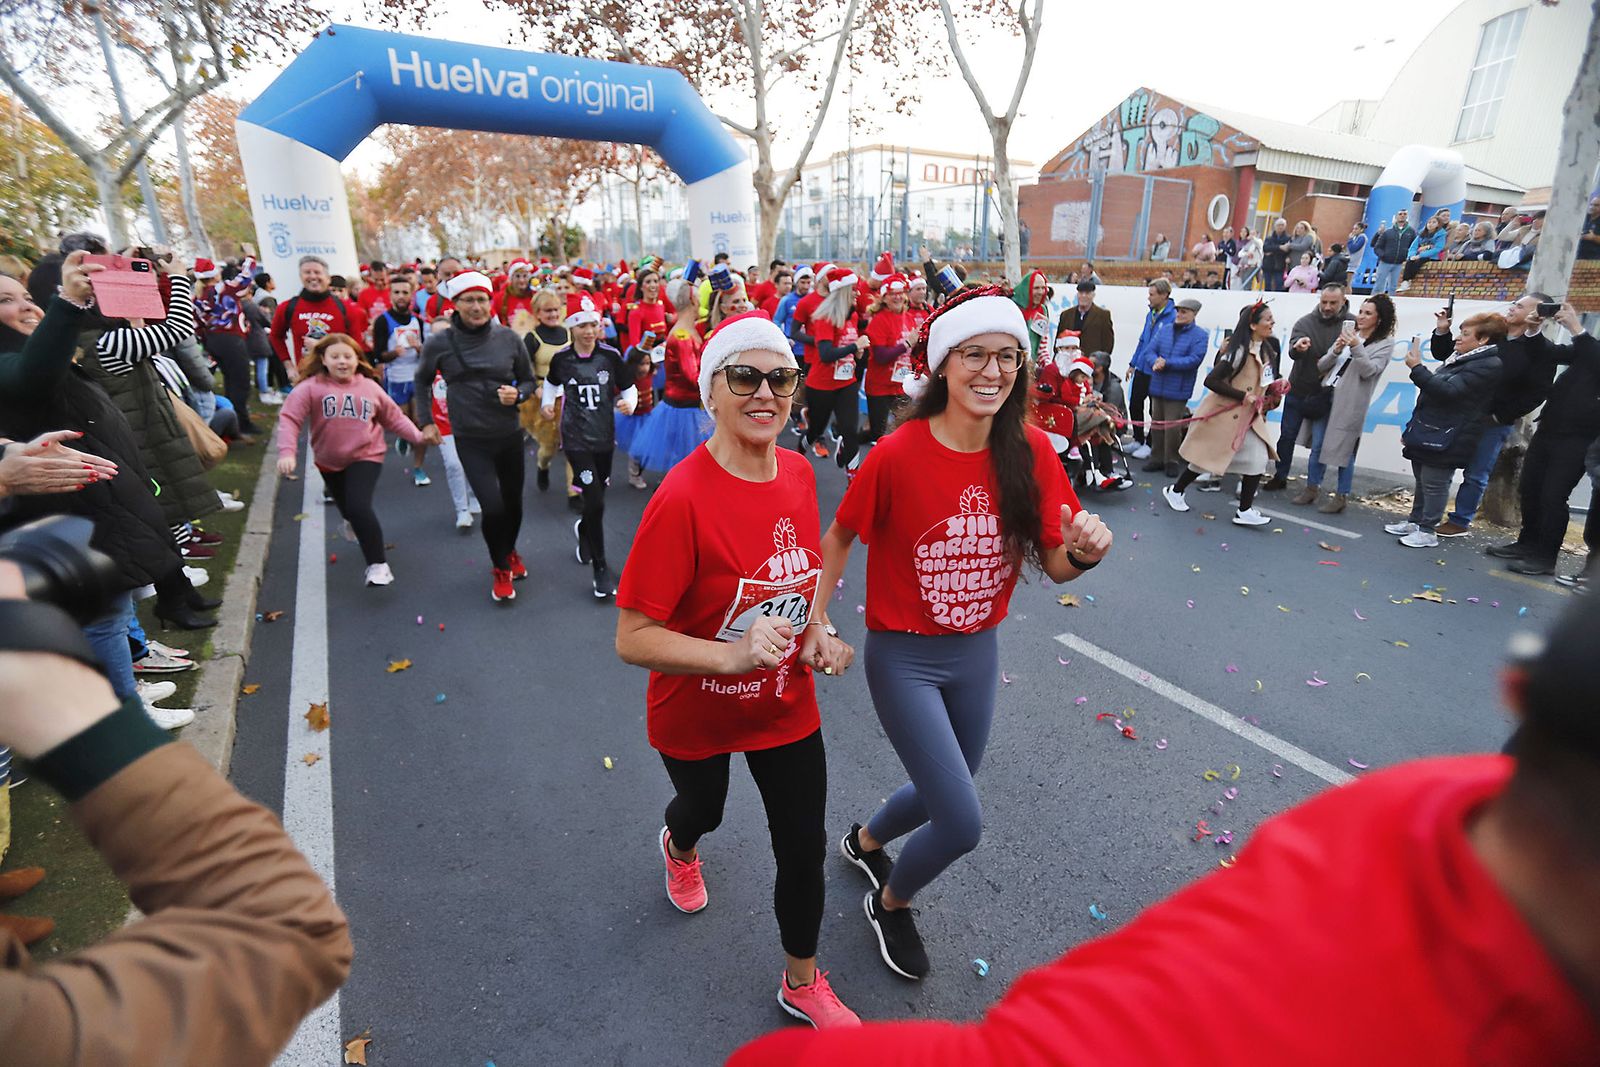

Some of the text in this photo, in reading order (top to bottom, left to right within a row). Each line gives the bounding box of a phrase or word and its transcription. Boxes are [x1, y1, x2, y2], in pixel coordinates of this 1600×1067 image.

[388, 47, 655, 115] Huelva original
[261, 193, 333, 212] Huelva
[323, 395, 373, 421] GAP
[946, 515, 998, 536] XIII
[768, 548, 809, 580] XIII
[932, 601, 992, 627] 2023
[701, 678, 767, 695] Huelva
